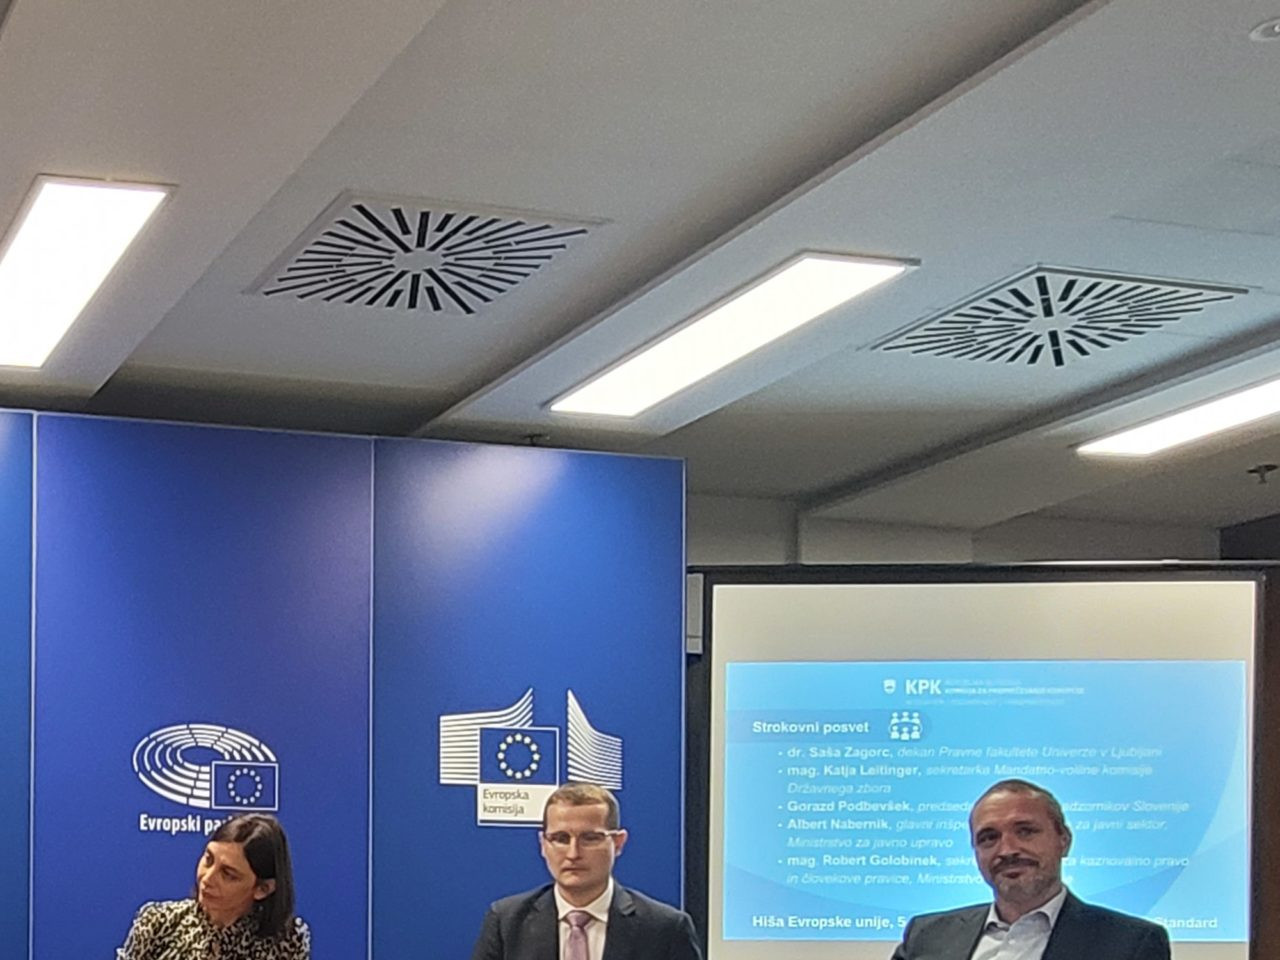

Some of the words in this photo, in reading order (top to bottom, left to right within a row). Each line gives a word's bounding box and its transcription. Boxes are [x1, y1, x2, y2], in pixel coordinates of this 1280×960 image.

[906, 680, 942, 694] KPK
[753, 722, 819, 733] Strokovni
[823, 722, 869, 735] posvet
[787, 747, 806, 757] dr.
[809, 746, 841, 758] Saša
[844, 747, 893, 760] Zagorc,
[897, 746, 935, 757] dekan
[938, 747, 982, 757] Pravne
[787, 767, 820, 778] mag.
[823, 765, 856, 778] Katja
[860, 765, 921, 778] Leitinger,
[926, 765, 990, 775] sekretarka
[482, 789, 529, 801] Evropska
[787, 783, 854, 796] Državnega
[857, 783, 891, 794] zbora
[482, 804, 525, 816] komisija
[787, 801, 834, 812] Gorazd
[838, 801, 914, 812] Podbevšek,
[918, 801, 970, 814] predsed
[1132, 801, 1190, 814] Slovenije
[139, 813, 201, 835] Evropski
[787, 819, 827, 830] Albert
[831, 819, 892, 831] Nabernik,
[787, 837, 852, 848] Ministrstvo
[855, 839, 869, 848] za
[872, 837, 907, 850] javno
[910, 839, 953, 850] upravo
[823, 855, 866, 866] Robert
[870, 855, 941, 867] Golobinek,
[1153, 857, 1190, 868] pravo
[787, 873, 798, 884] in
[801, 872, 861, 884] človekove
[753, 916, 784, 927] Hiša
[788, 916, 852, 930] Evropske
[856, 916, 894, 930] unije,
